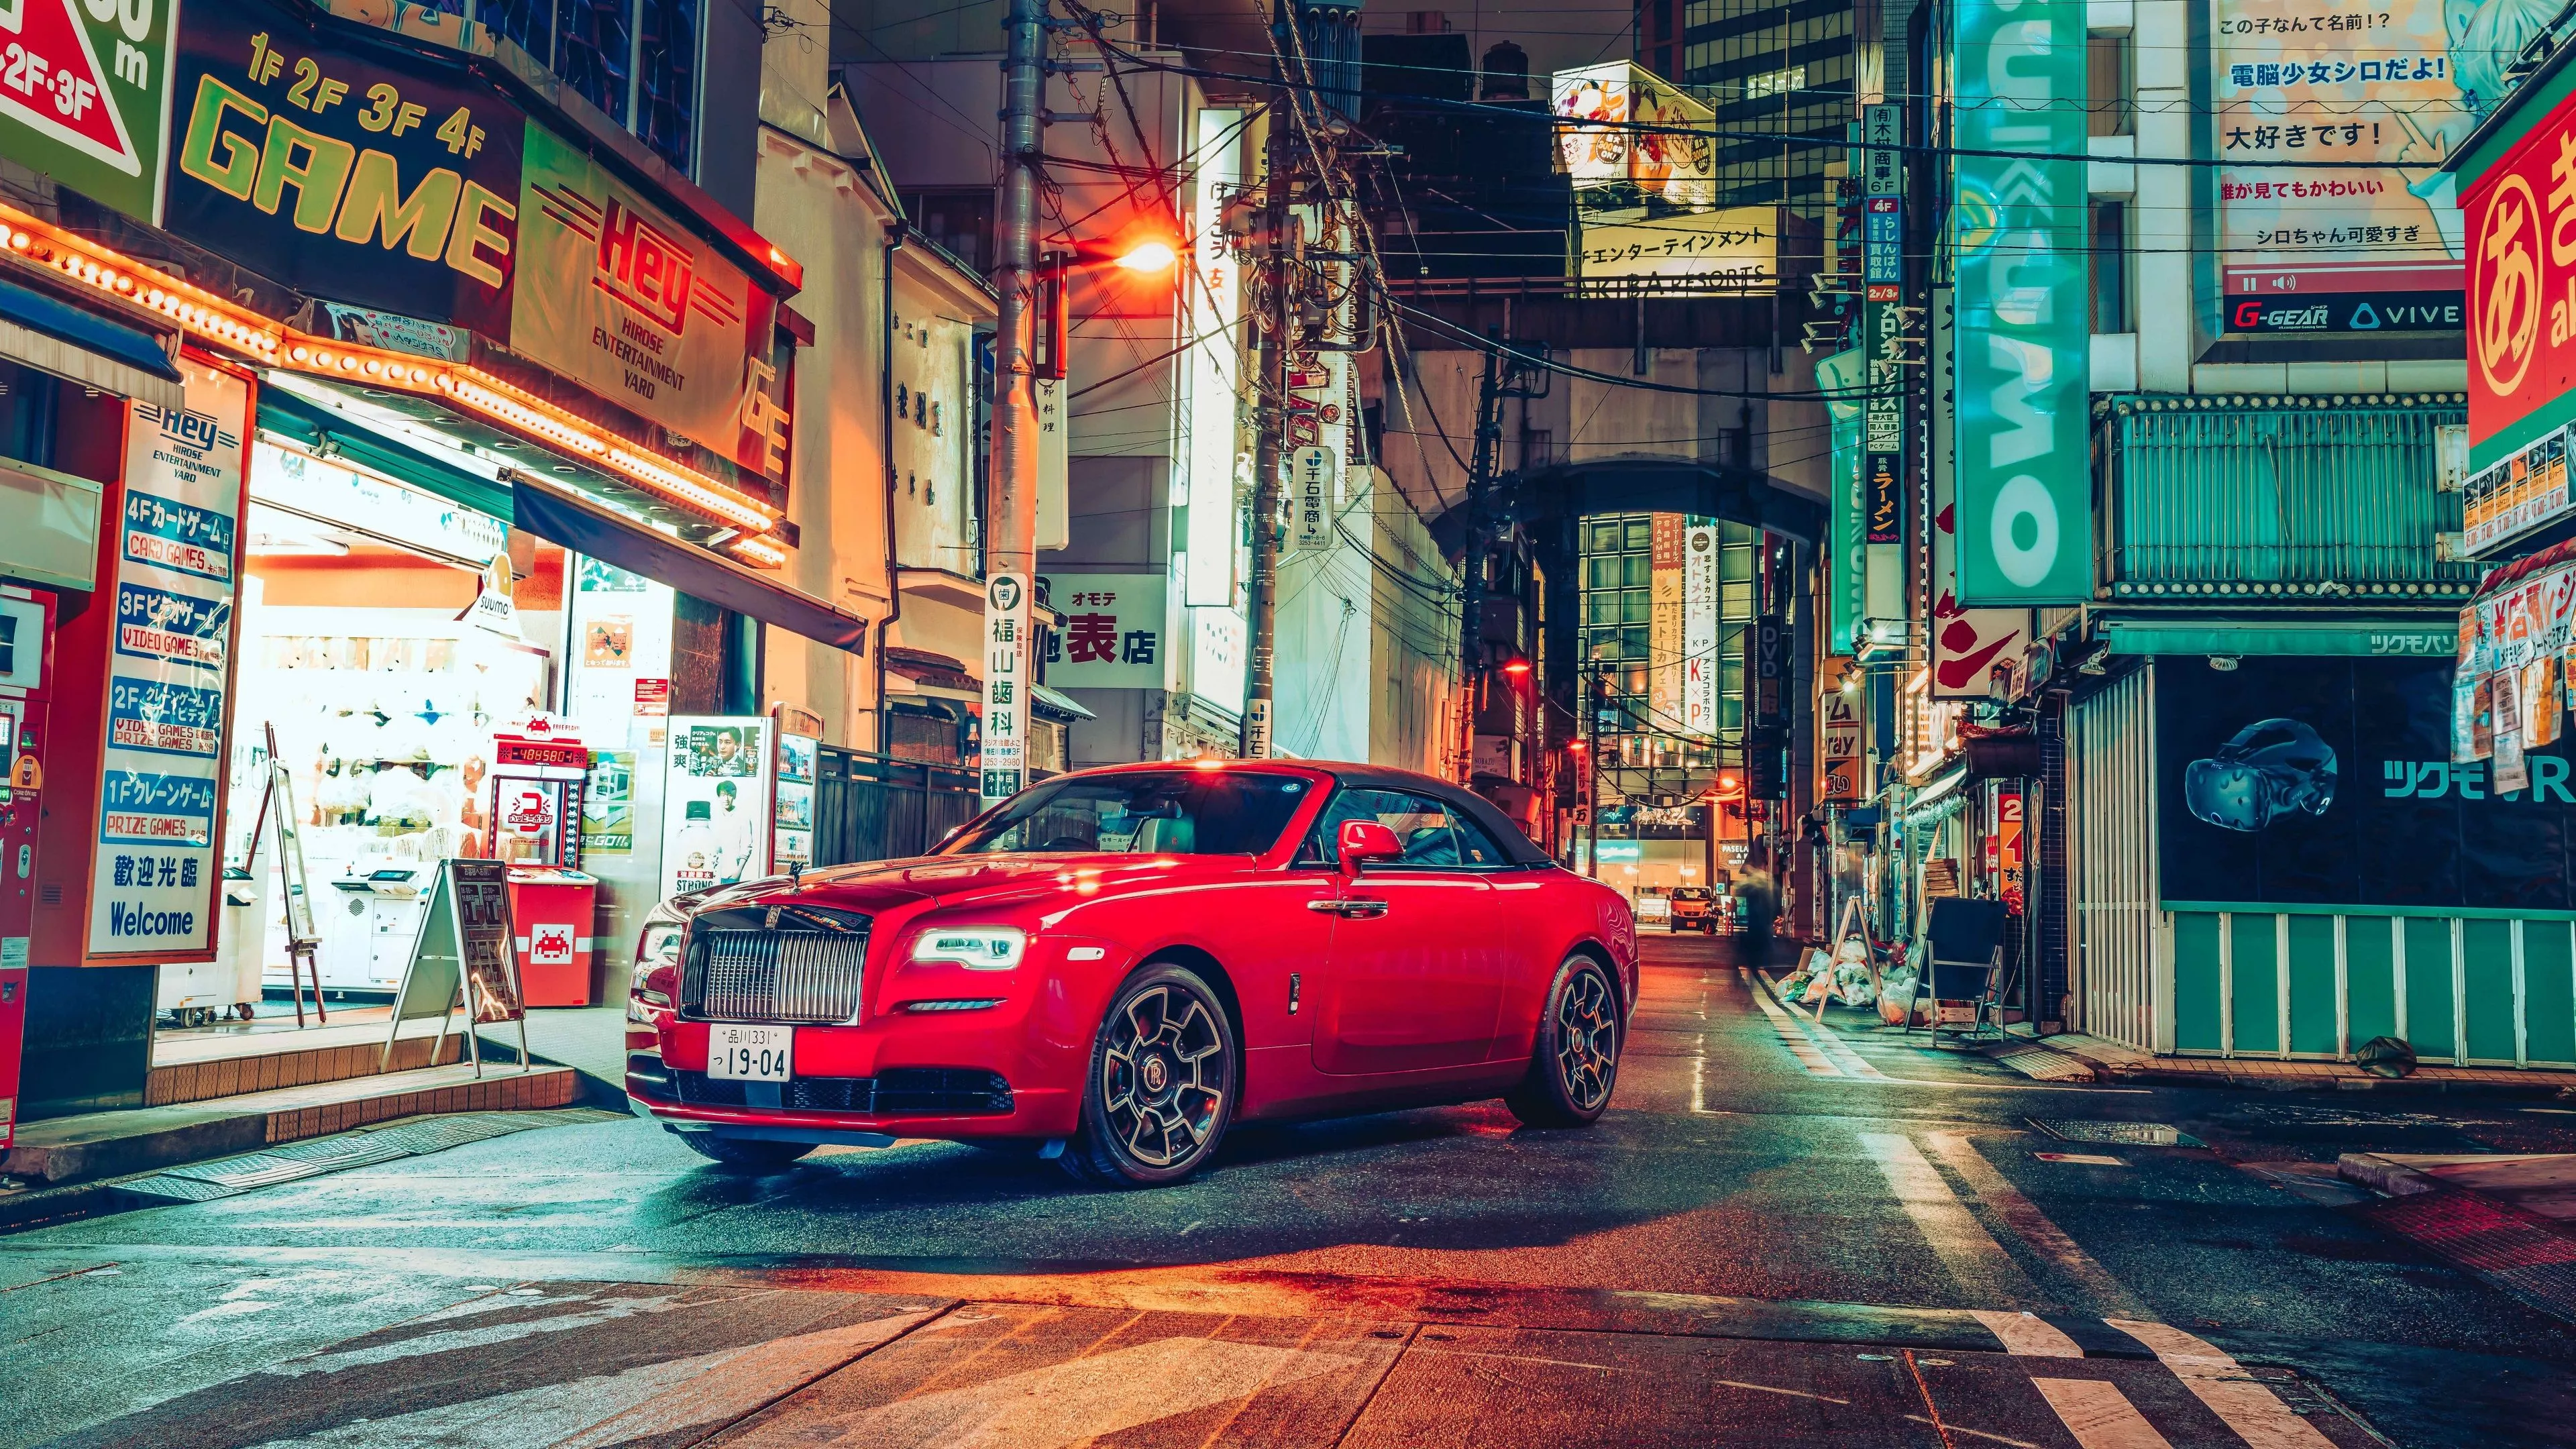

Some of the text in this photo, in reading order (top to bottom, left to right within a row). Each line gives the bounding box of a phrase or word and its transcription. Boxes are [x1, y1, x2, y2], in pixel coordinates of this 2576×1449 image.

[251, 32, 486, 158] 1F 2F 3F 4F
[180, 73, 516, 289] GAME
[1870, 181, 1894, 193] 6F
[1874, 199, 1892, 213] 4F
[1883, 215, 1897, 280] らしんばん
[2257, 225, 2420, 246] シロちゃん可愛すぎ
[597, 195, 693, 339] Hey
[1870, 244, 1882, 280] 買取館
[1988, 0, 2059, 588] UKUMO
[2234, 302, 2328, 327] G-GEAR
[2386, 307, 2459, 323] VIVE
[621, 317, 664, 356] HIROSE
[592, 326, 685, 392] ENTERTAINMENT
[623, 368, 655, 400] YARD
[1869, 423, 1898, 431] 同人音楽
[153, 449, 221, 478] ENTERTAINMENT
[172, 443, 203, 461] HIROSE
[174, 468, 197, 484] YARD
[1304, 468, 1321, 523] 千石電商
[1873, 472, 1894, 531] ラーメン
[129, 534, 205, 571] CARD GAMES
[998, 588, 1010, 600] 歯
[1071, 592, 1117, 607] オモテ
[1691, 555, 1702, 620] オトメイト
[123, 627, 199, 658] VIDEO GAMES
[1761, 627, 1778, 678] DVD
[990, 618, 1015, 737] 福山歯科
[1703, 658, 1711, 726] アニメコラボカフェ
[115, 684, 140, 710] 2F
[158, 724, 194, 739] GAMES
[158, 737, 193, 751] GAMES
[1249, 725, 1265, 759] 千石
[673, 734, 689, 769] 強爽
[987, 775, 1014, 783] 外神田
[107, 814, 186, 837] PRIZE GAMES
[113, 855, 198, 888] 歡迎光臨
[111, 900, 193, 936] Welcome
[729, 1047, 785, 1077] 19-04
